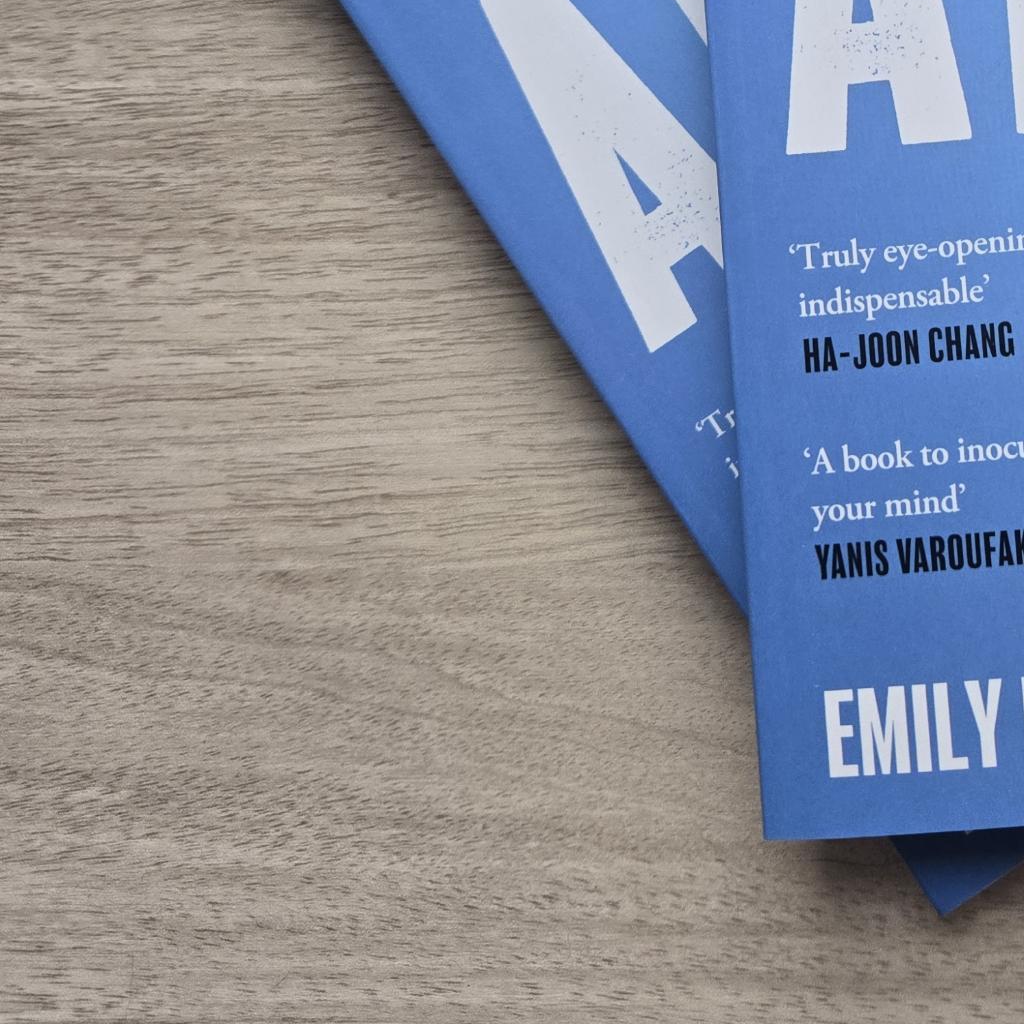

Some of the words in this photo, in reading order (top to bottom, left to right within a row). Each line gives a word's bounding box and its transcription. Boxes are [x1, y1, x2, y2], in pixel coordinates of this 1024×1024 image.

[788, 238, 876, 274] ‘Truly
[799, 273, 990, 322] indispensable’
[803, 329, 920, 373] HA-JOON
[928, 320, 1016, 364] CHANG
[803, 446, 835, 475] ‘A
[841, 439, 914, 473] book
[920, 445, 949, 466] to
[810, 501, 876, 532] your
[884, 483, 966, 518] mind’
[814, 539, 890, 580] YANIS
[823, 677, 1003, 779] EMILY
